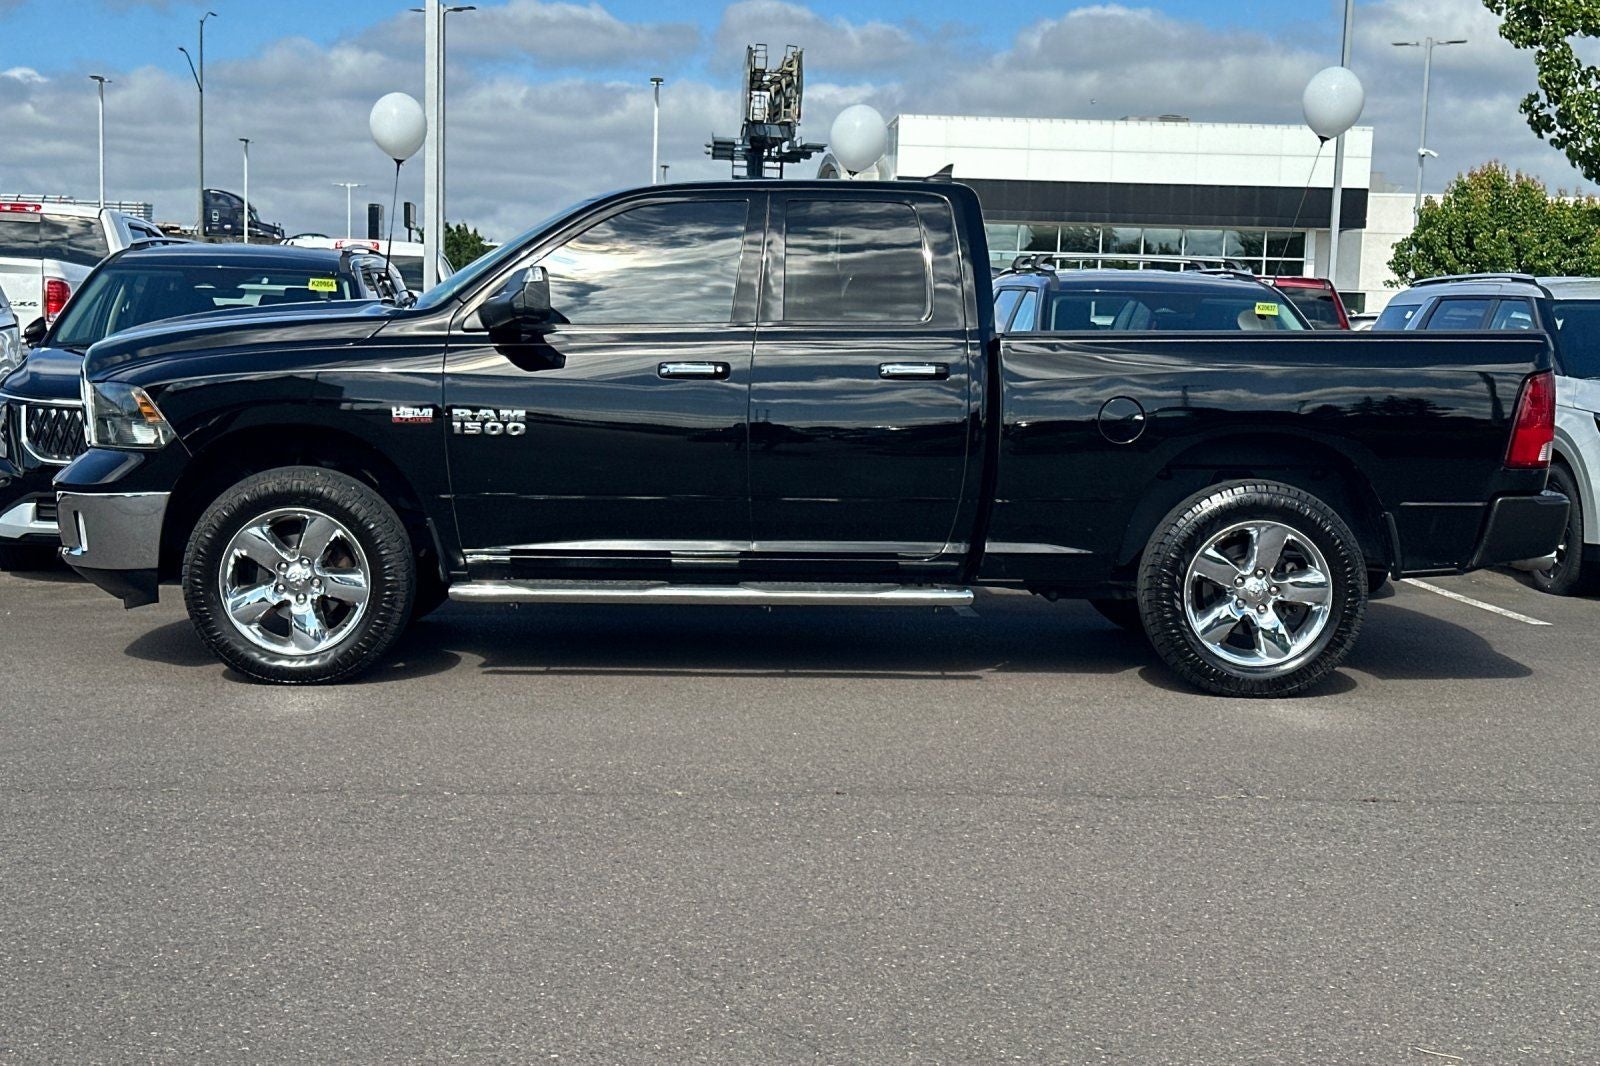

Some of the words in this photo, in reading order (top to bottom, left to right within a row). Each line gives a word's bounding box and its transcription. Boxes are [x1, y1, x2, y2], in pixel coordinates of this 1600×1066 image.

[392, 407, 433, 417] HEMI
[452, 408, 526, 421] RAM
[452, 422, 526, 435] 1500
